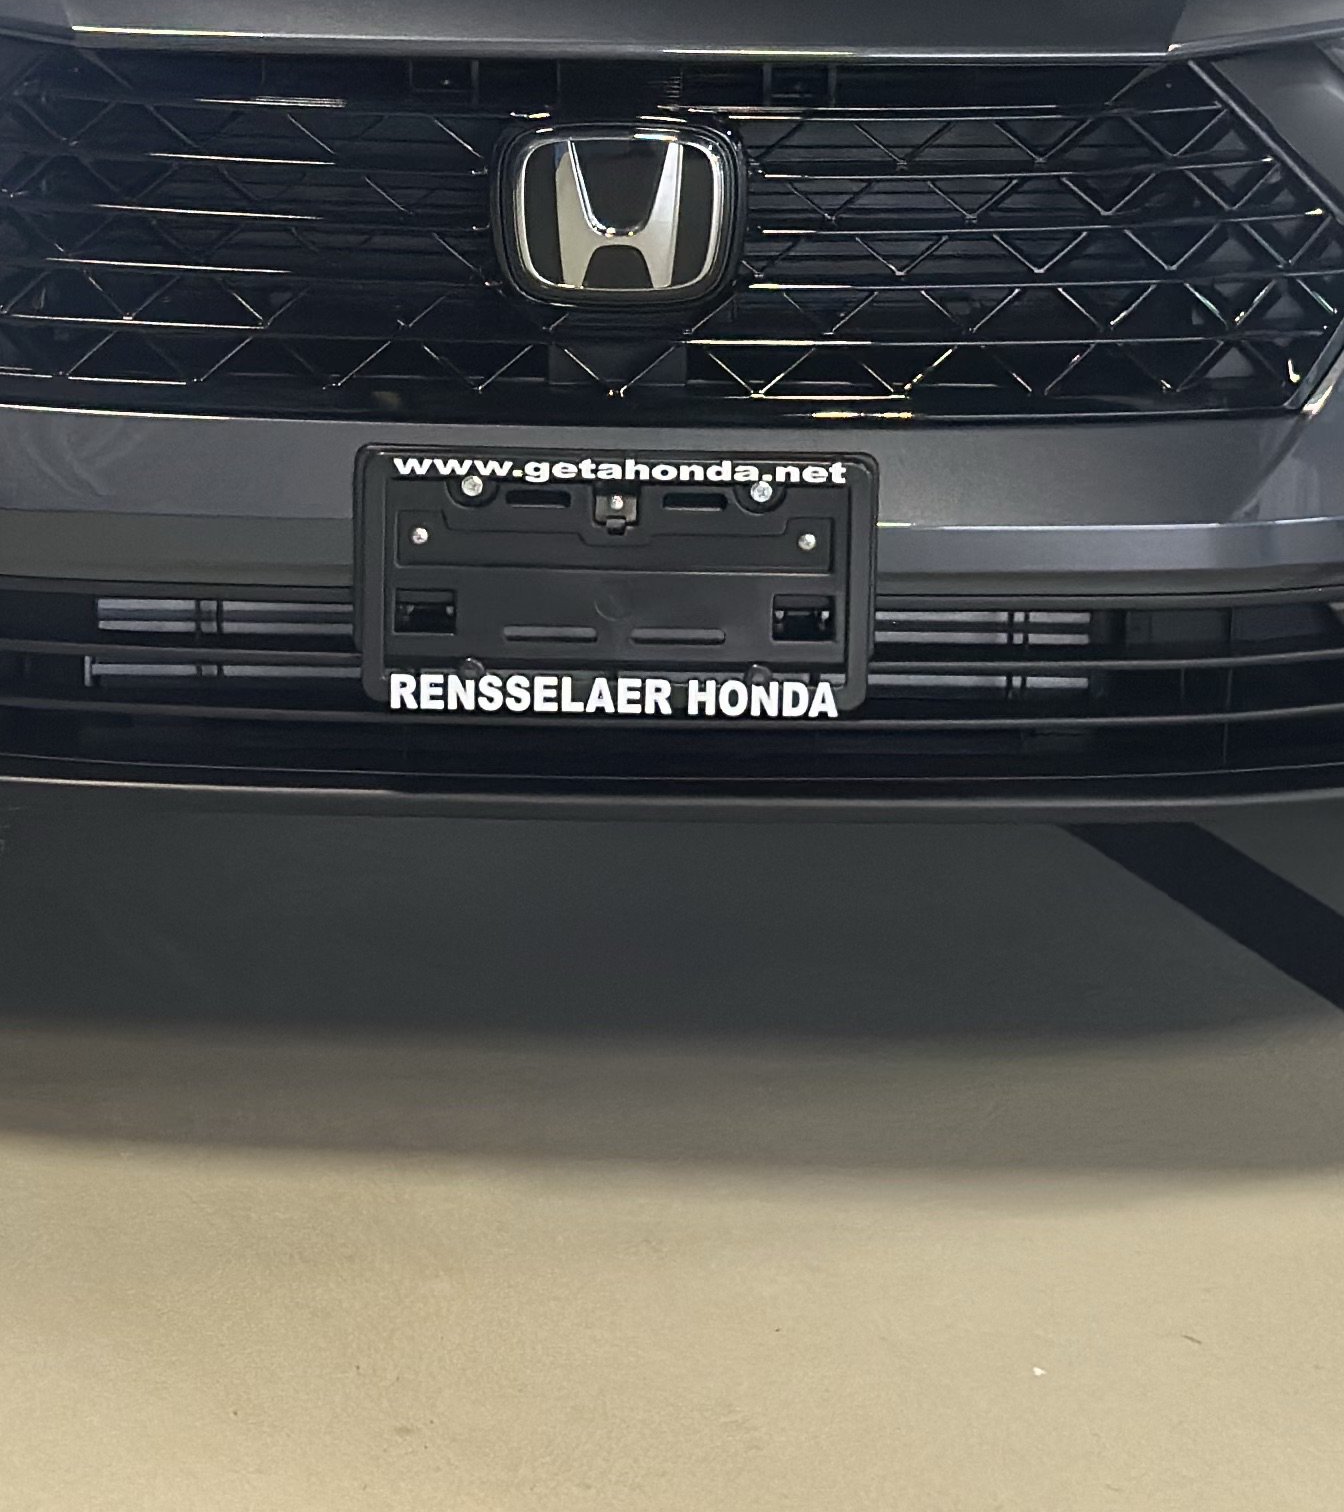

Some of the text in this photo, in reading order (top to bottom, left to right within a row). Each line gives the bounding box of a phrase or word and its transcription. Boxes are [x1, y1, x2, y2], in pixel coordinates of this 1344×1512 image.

[392, 456, 847, 485] www.getahonda.net
[389, 673, 840, 719] RENSSELAER HONDA
